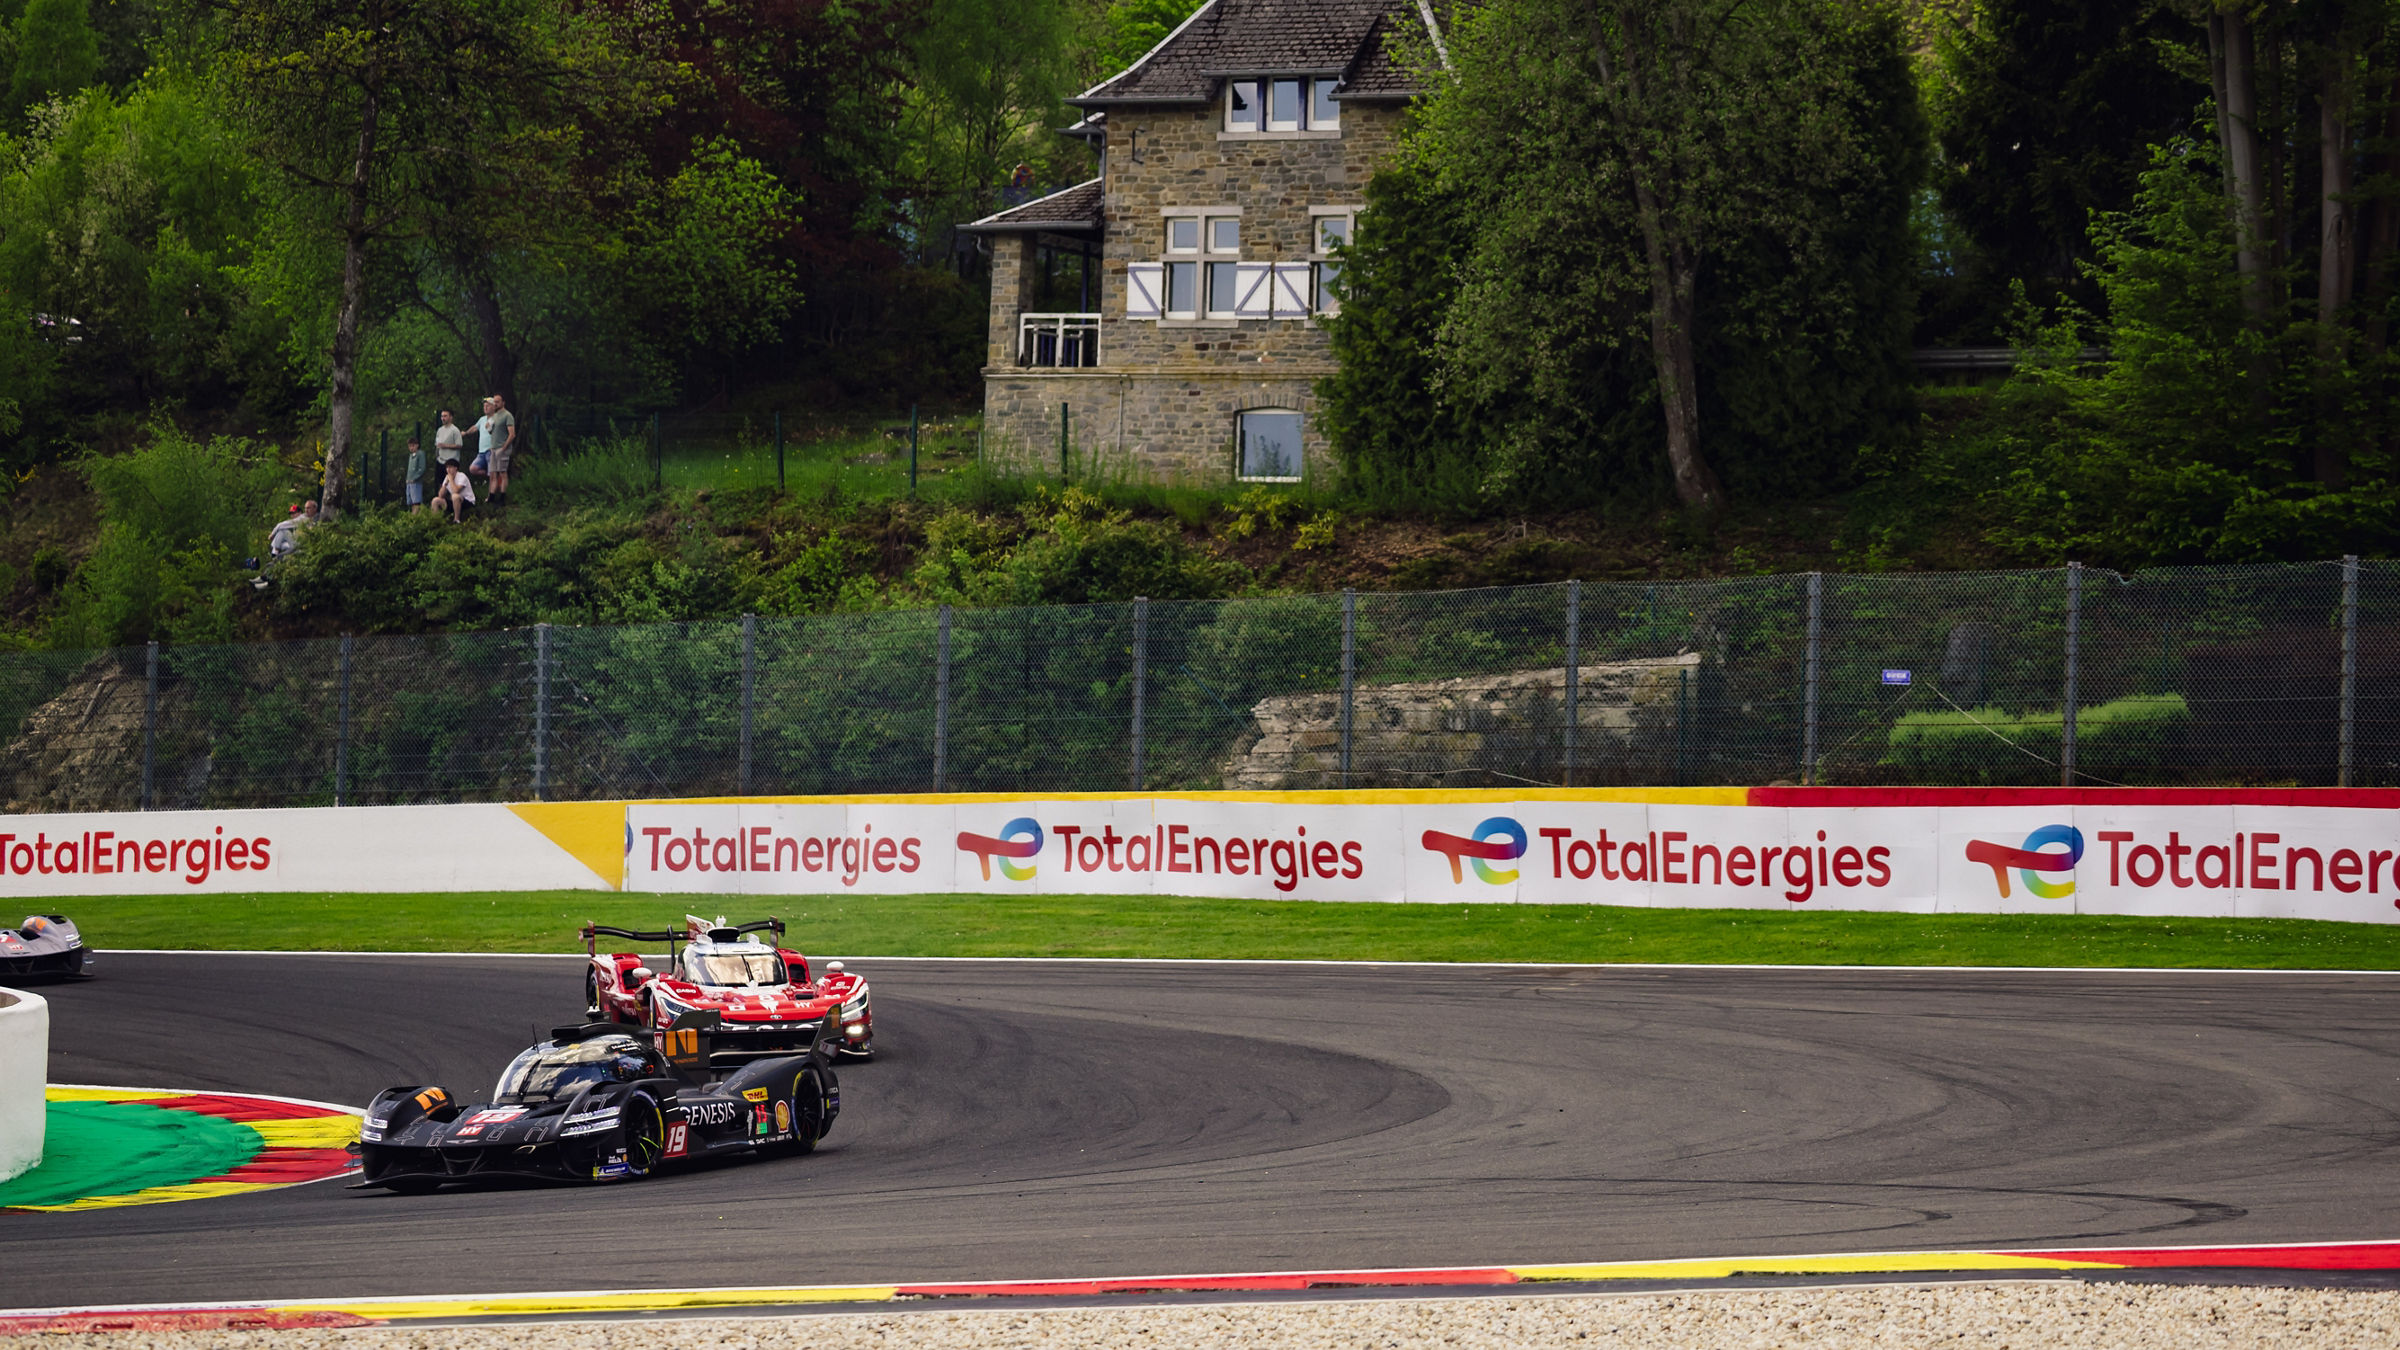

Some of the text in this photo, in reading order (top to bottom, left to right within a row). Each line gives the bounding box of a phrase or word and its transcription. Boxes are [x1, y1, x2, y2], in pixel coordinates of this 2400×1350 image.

[0, 826, 270, 884] TotalEnergies
[643, 825, 920, 886] TotalEnergies
[1053, 825, 1363, 892] TotalEnergies
[1539, 828, 1891, 902] TotalEnergies
[2098, 831, 2400, 910] TotalEner
[747, 1091, 764, 1099] DHL
[459, 1126, 481, 1135] HY
[667, 1125, 686, 1153] 19
